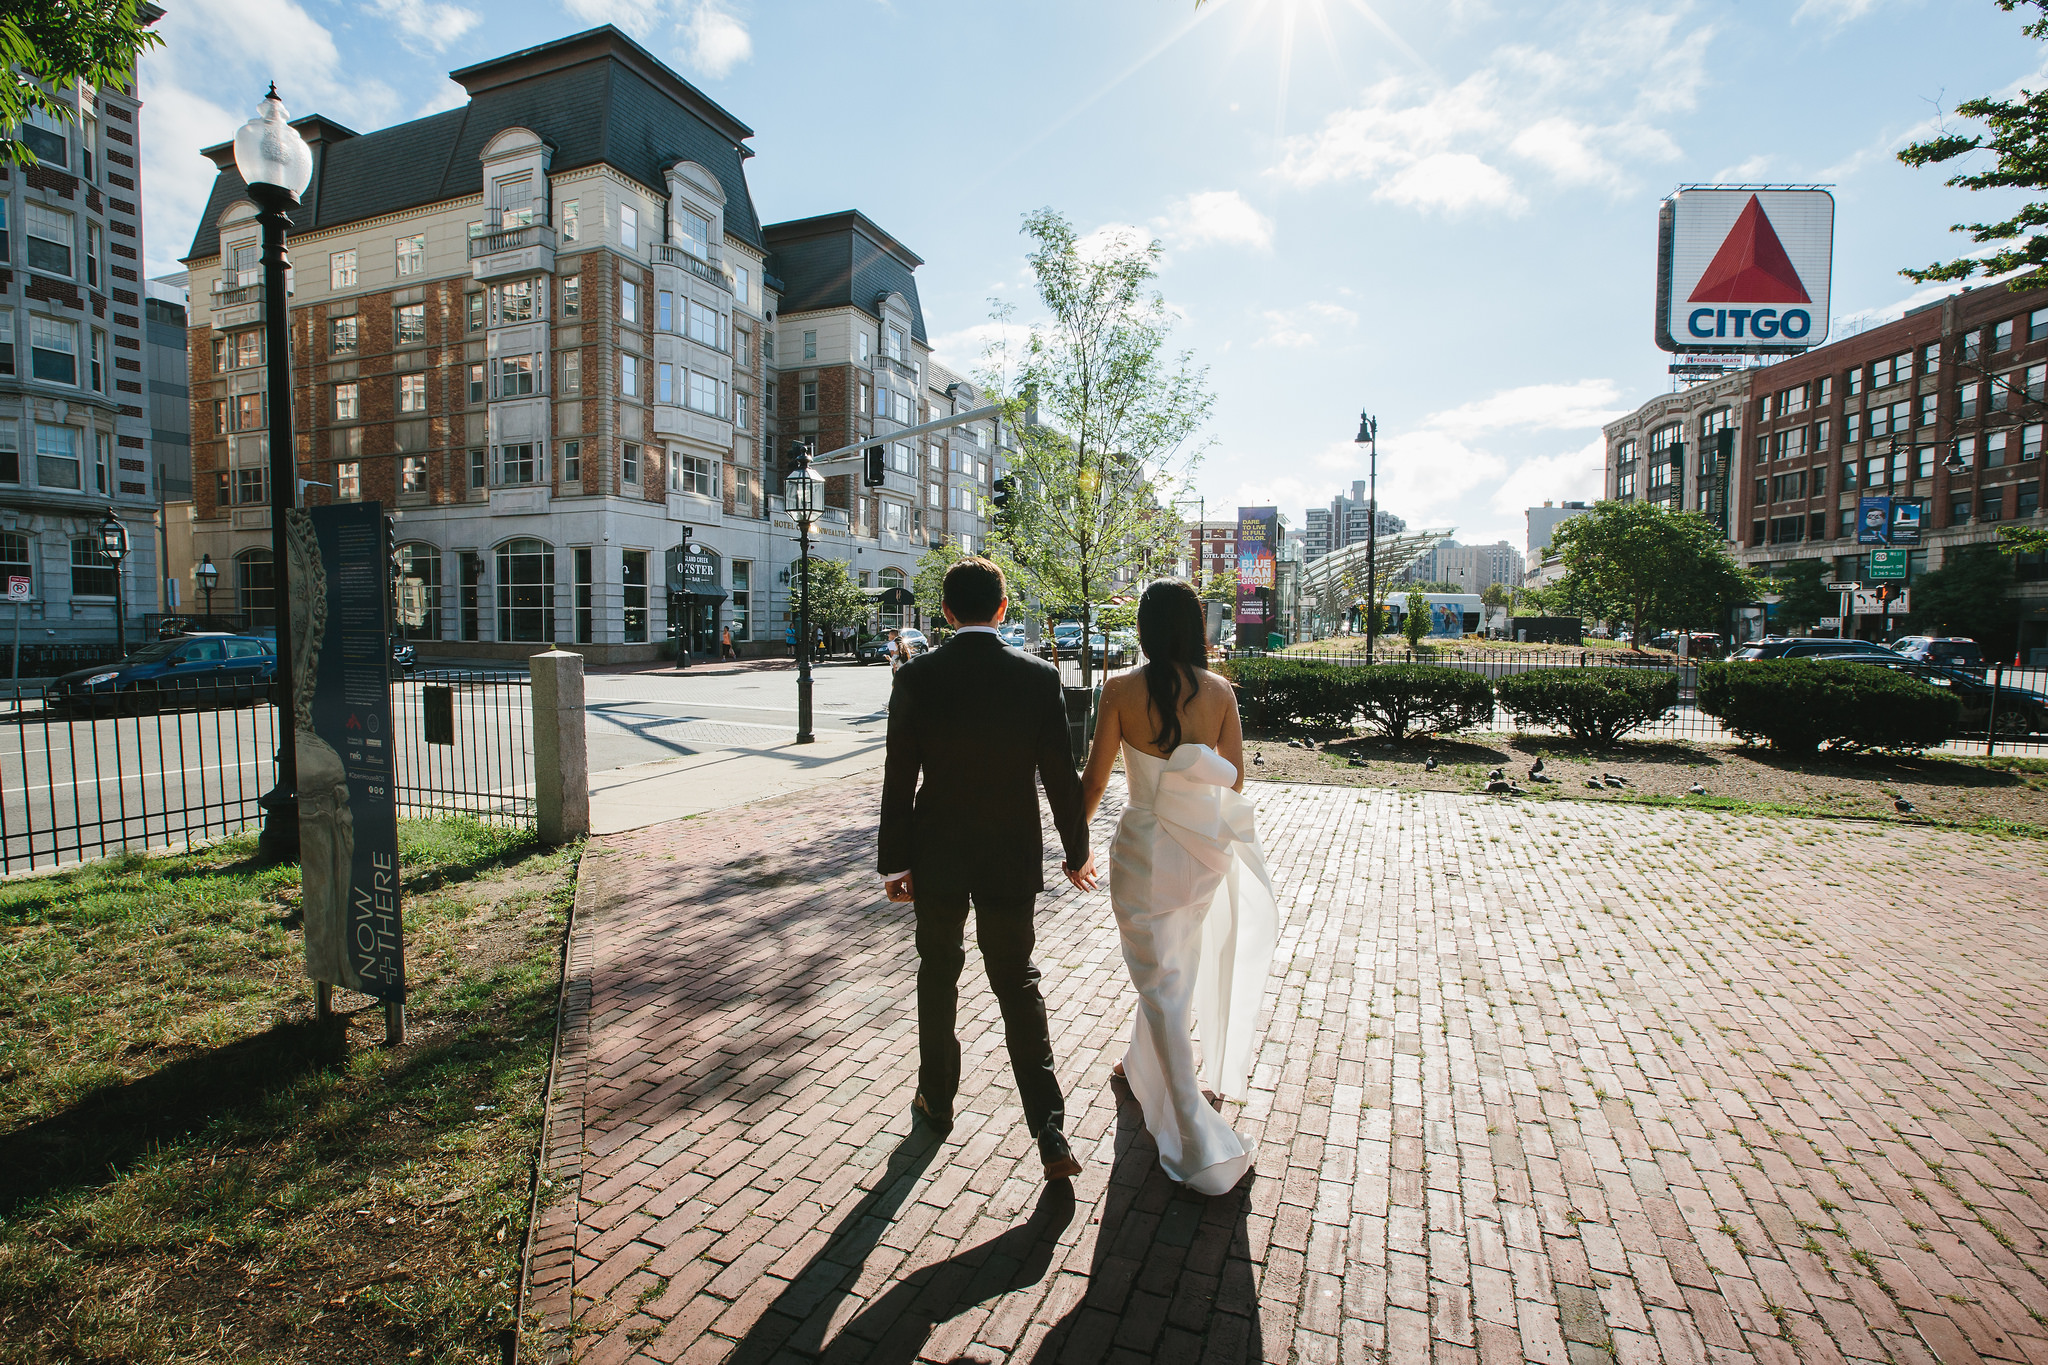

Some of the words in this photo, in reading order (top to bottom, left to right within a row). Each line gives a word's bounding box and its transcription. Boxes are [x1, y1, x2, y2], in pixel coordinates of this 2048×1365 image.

[1688, 307, 1811, 339] CITGO
[774, 520, 795, 530] HOTEL
[1875, 553, 1886, 561] 20
[1241, 559, 1271, 568] BLUE
[1241, 568, 1271, 578] MAN
[1241, 577, 1271, 585] GROUP
[372, 851, 396, 953] THERE
[354, 886, 377, 979] NOW
